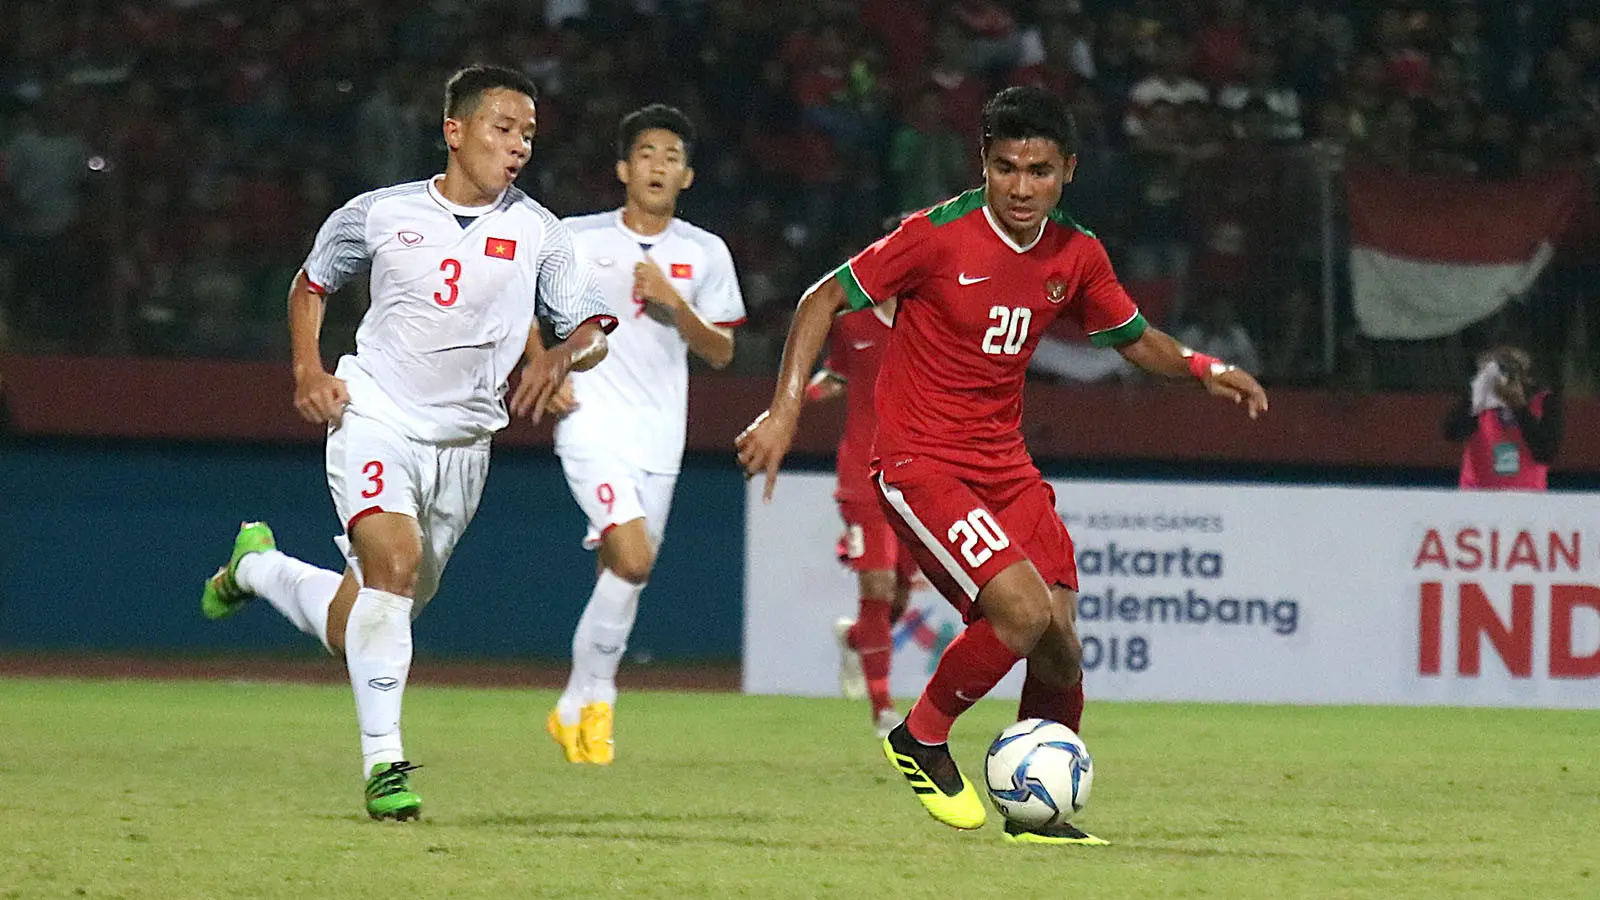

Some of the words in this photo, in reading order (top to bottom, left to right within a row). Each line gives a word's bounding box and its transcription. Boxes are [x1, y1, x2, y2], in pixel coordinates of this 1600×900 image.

[433, 258, 462, 307] 3
[981, 305, 1033, 355] 20
[361, 460, 385, 499] 3
[596, 483, 616, 515] 9
[947, 508, 1010, 568] 20
[1077, 542, 1224, 579] akarta
[1413, 528, 1581, 572] ASIAN
[1077, 587, 1298, 636] alembang
[1418, 582, 1600, 679] IND
[1080, 636, 1151, 673] 018
